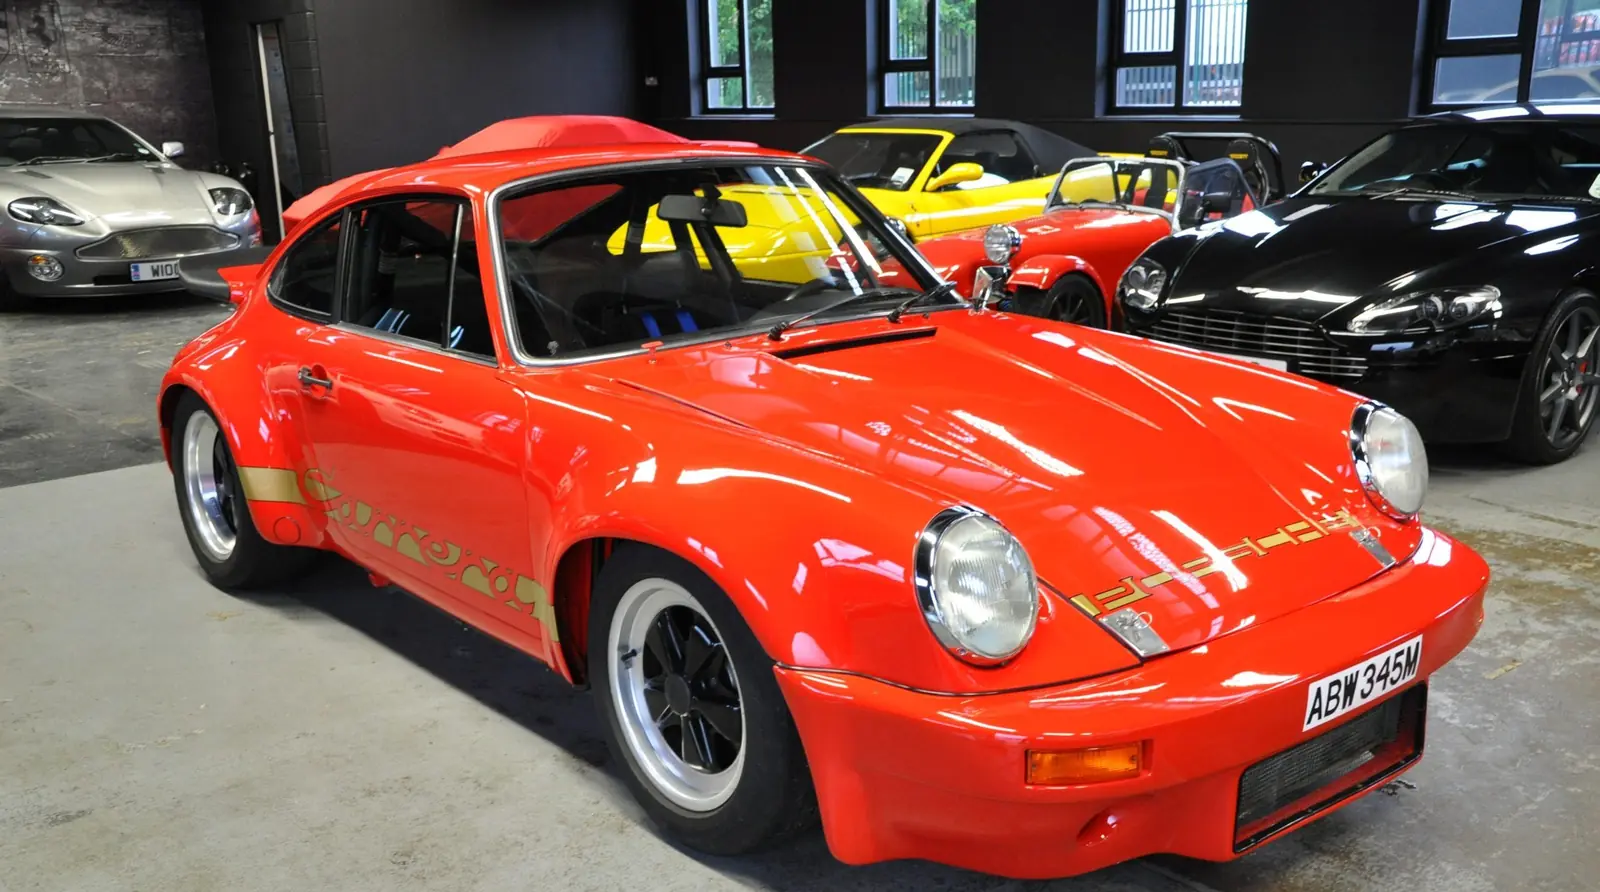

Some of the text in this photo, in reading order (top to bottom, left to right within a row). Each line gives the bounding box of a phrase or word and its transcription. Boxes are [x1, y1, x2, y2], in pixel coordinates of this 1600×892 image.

[296, 464, 540, 617] Carrera
[1306, 641, 1420, 725] ABW 345M
